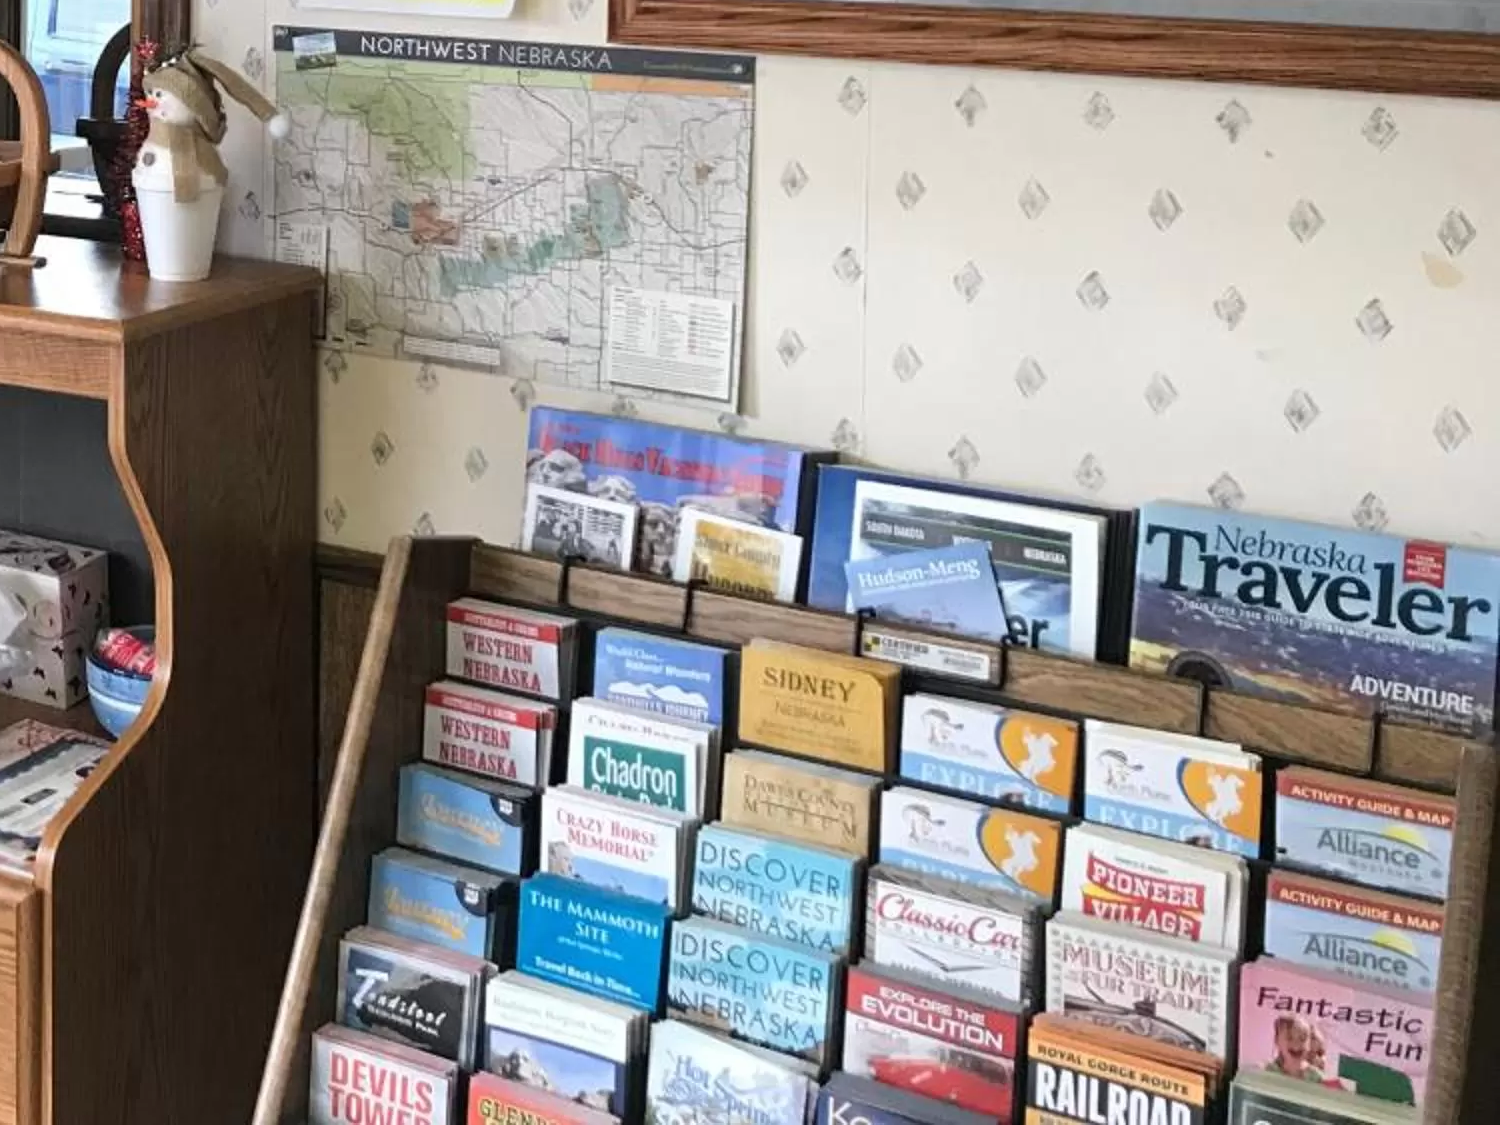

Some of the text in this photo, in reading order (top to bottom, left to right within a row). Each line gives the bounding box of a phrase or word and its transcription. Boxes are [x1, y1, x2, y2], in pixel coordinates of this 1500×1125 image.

[361, 34, 491, 61] NORTHWEST
[499, 44, 612, 70] NEBRASKA
[1023, 546, 1068, 565] NEBRASKA
[1215, 524, 1368, 575] Nebraska
[858, 558, 981, 589] Hudson-Meng
[1145, 523, 1491, 642] Traveler
[463, 631, 533, 665] WESTERN
[463, 658, 541, 693] NEBRASKA
[763, 666, 856, 703] SIDNEY
[1350, 675, 1474, 715] ADVENTURE
[440, 715, 510, 750] WESTERN
[775, 700, 845, 728] NEBRASKA
[439, 740, 517, 779] NEBRASKA
[591, 747, 677, 798] Chadron
[1291, 784, 1451, 825] ACTIVITY GUIDE & MAP
[557, 807, 657, 845] CRAZY HORSE
[1317, 828, 1421, 869] Alliance
[700, 841, 840, 900] DISCOVER
[1092, 860, 1199, 908] PIONEER
[530, 890, 658, 939] THE MAMMOTH
[699, 869, 840, 924] NORTHWEST
[1092, 898, 1194, 937] VILLAGE
[1279, 886, 1440, 932] ACTIVITY GUIDE & MAP
[576, 921, 609, 944] SITE
[699, 894, 836, 952] NEBRASKA
[877, 892, 1021, 949] Classic Car
[535, 955, 566, 974] Travel
[567, 965, 592, 983] Back
[594, 973, 605, 985] in
[681, 933, 823, 991] DISCOVER
[1064, 943, 1209, 996] MUSEUM
[1303, 934, 1408, 976] Alliance
[679, 962, 822, 1016] NORTHWEST
[679, 988, 819, 1047] NEBRASKA
[861, 994, 1004, 1051] EVOLUTION
[955, 1006, 986, 1026] THE
[1257, 986, 1424, 1035] Fantastic
[1364, 1032, 1423, 1062] Fun
[330, 1050, 433, 1115] DEVILS
[1037, 1044, 1190, 1095] ROYAL GORGE ROUTE
